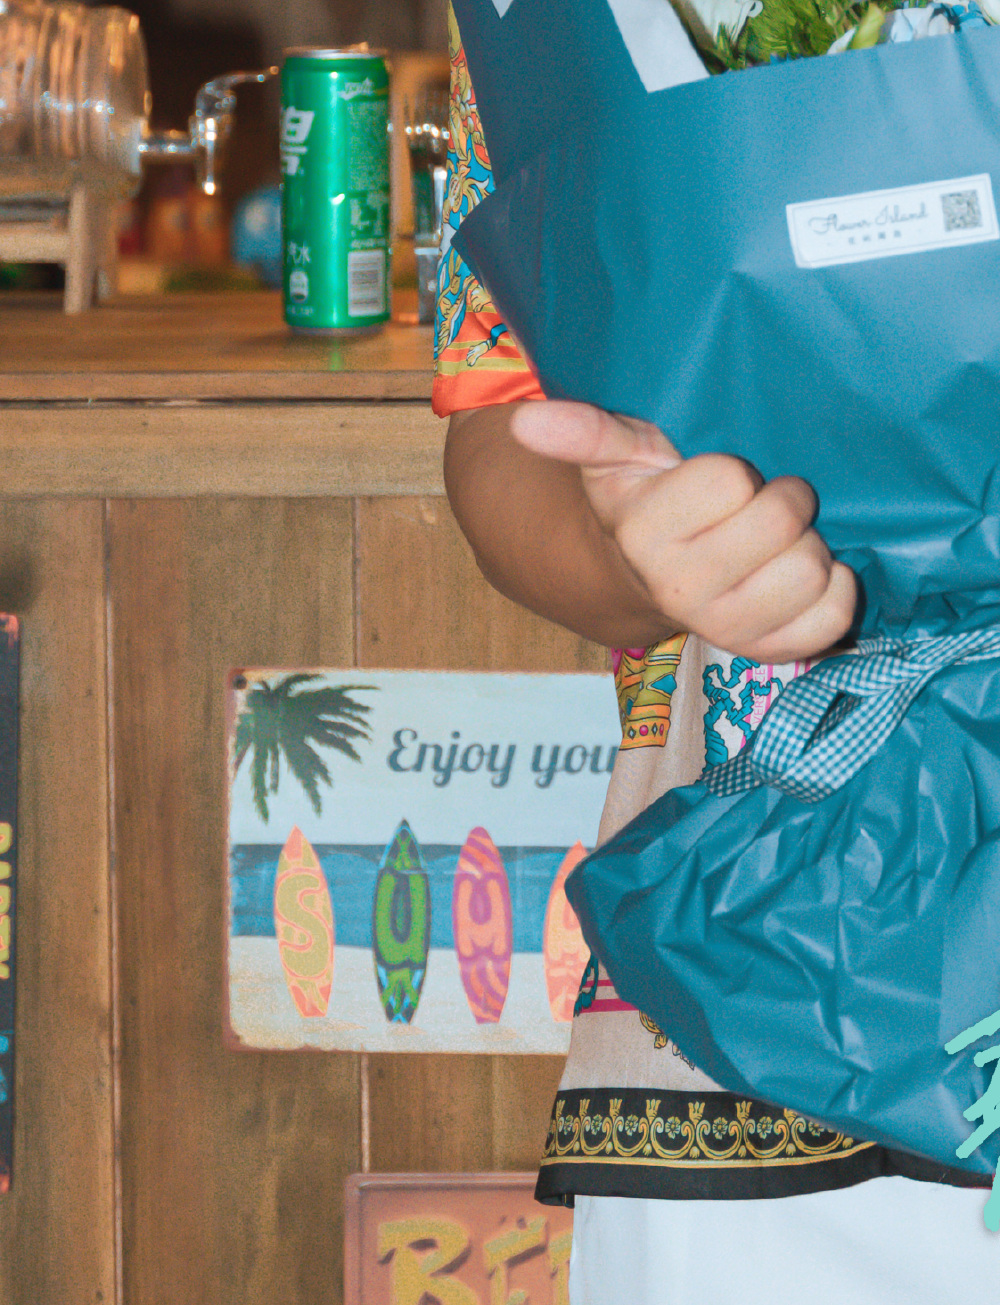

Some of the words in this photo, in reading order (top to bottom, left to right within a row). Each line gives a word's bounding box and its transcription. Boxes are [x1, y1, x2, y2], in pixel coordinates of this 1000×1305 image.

[807, 212, 871, 234] Flower
[875, 202, 928, 225] Island
[752, 667, 767, 725] VERCE
[386, 727, 517, 789] Enjoy
